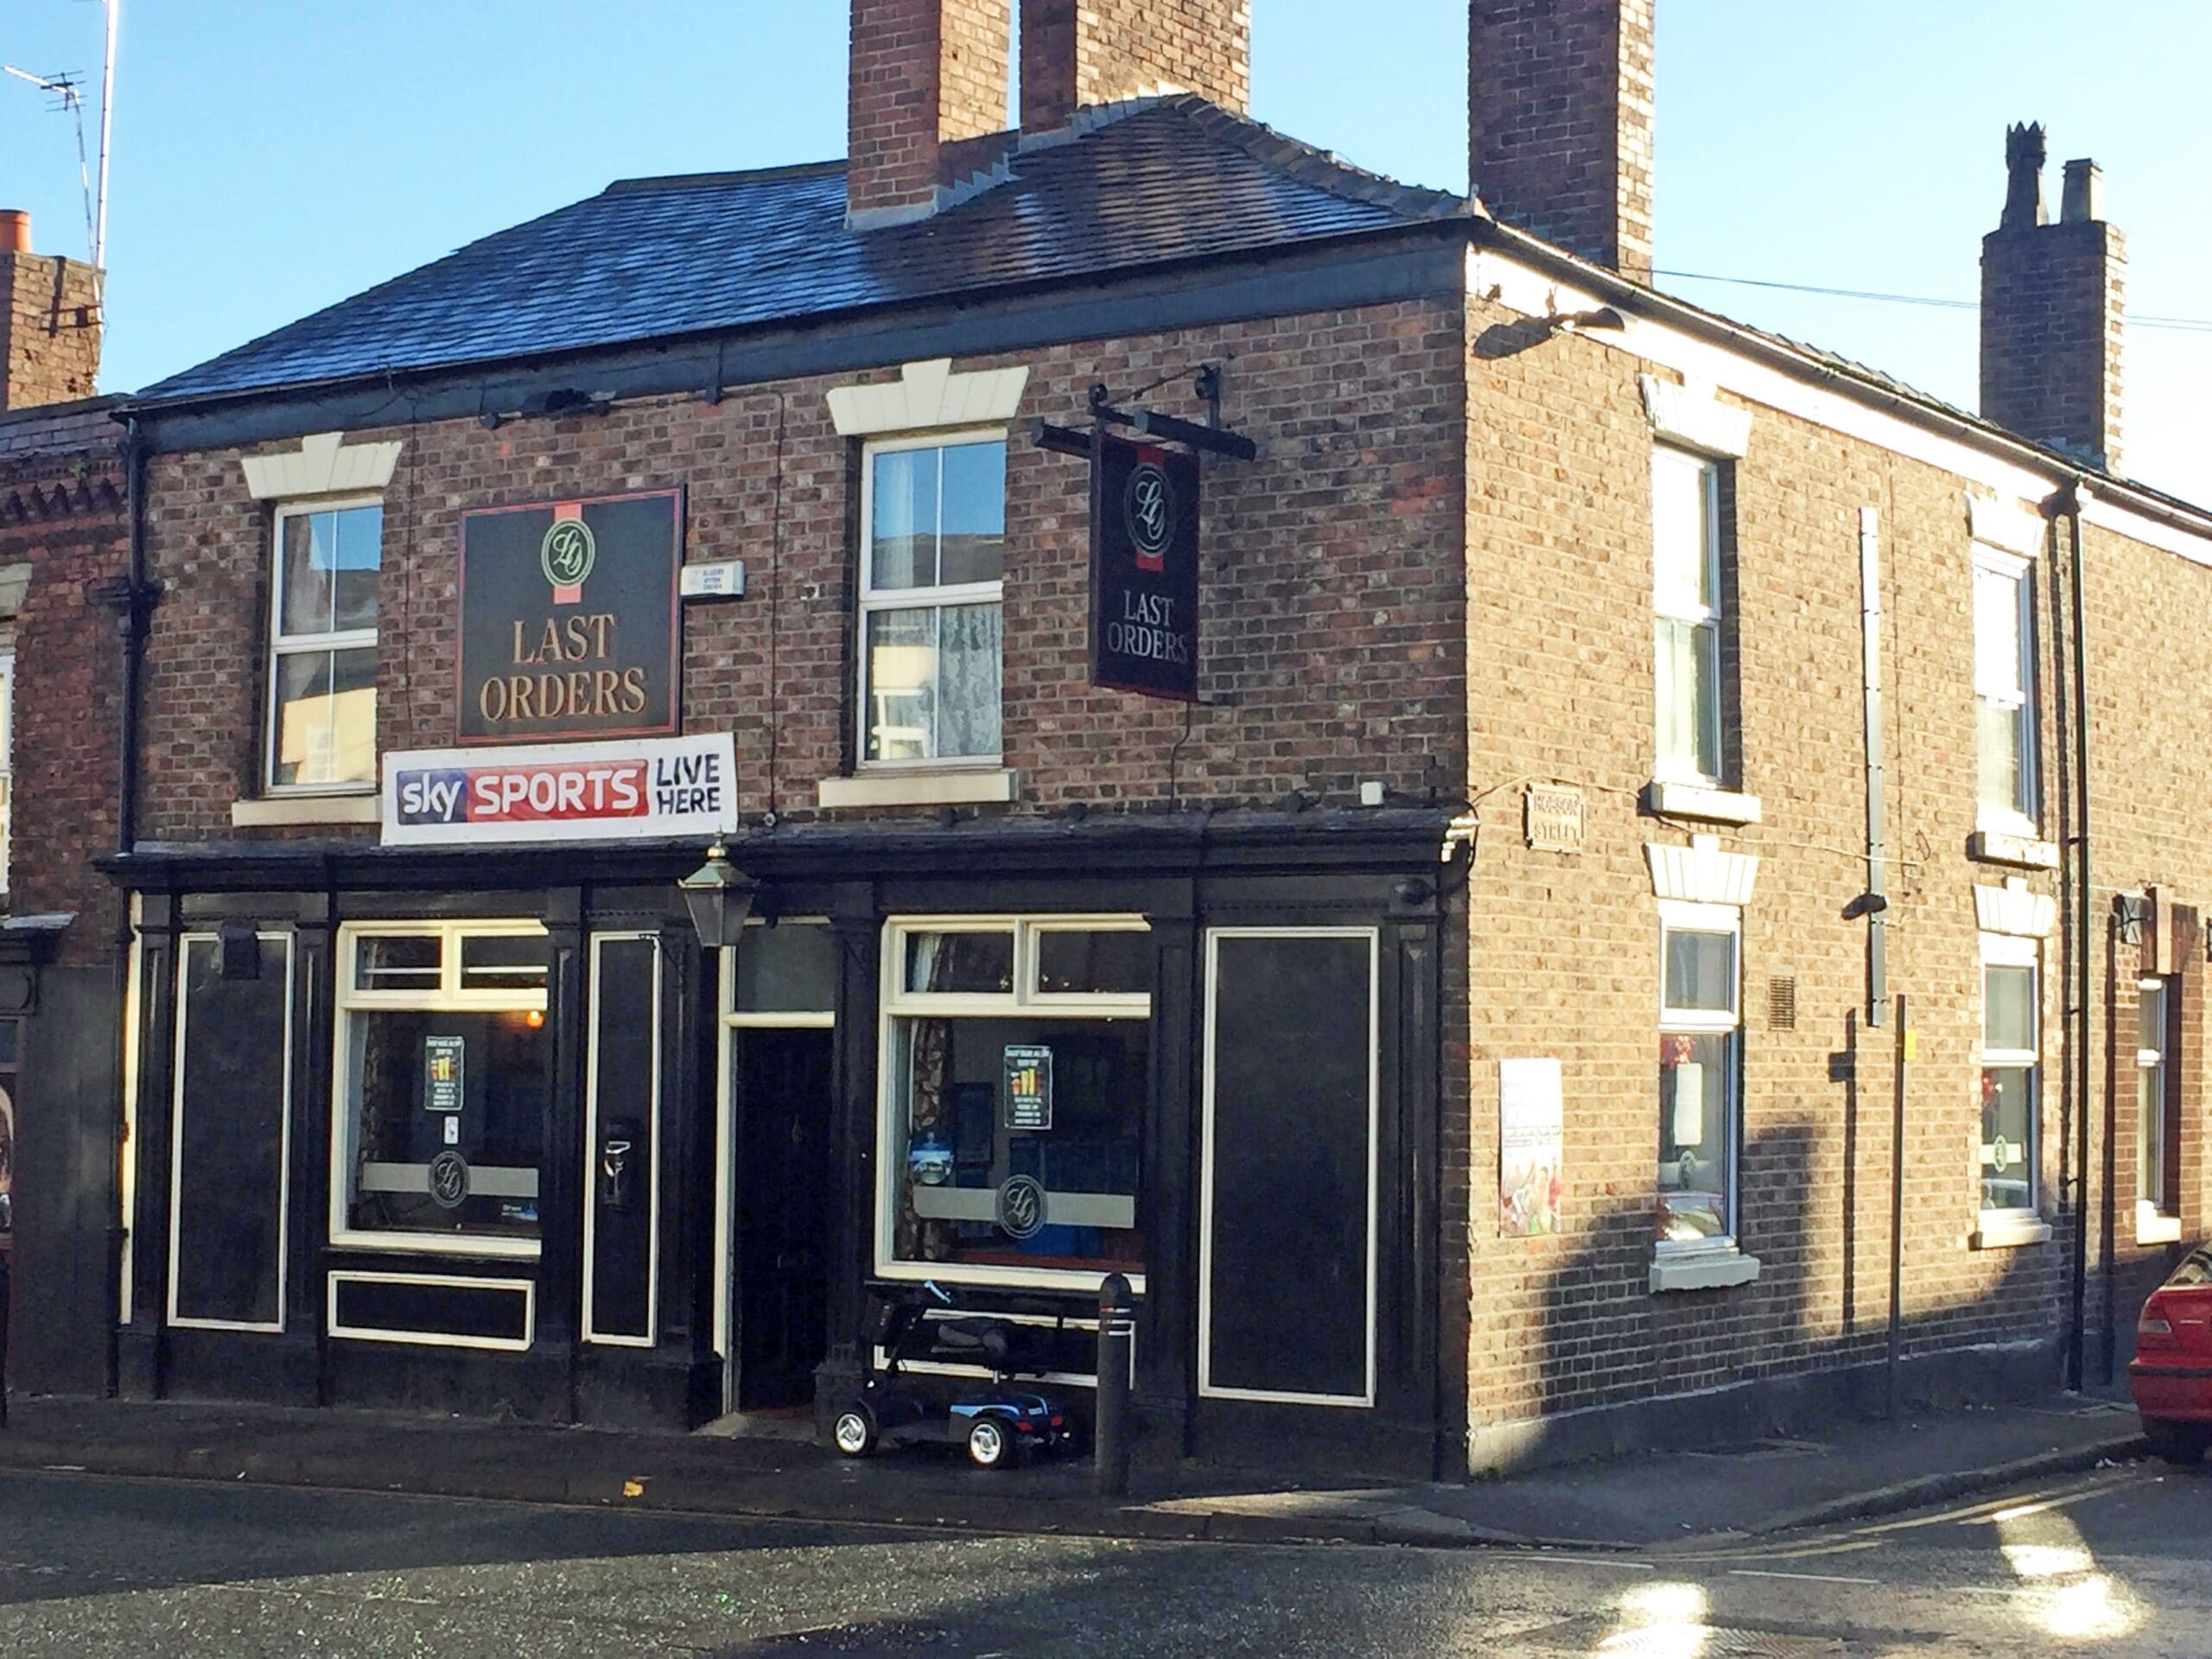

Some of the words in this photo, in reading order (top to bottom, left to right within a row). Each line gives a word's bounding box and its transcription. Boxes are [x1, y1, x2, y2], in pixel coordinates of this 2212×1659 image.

[1123, 589, 1174, 627] LAST
[512, 614, 617, 665] LAST
[1107, 622, 1189, 664] ORDERS
[480, 667, 646, 722] ORDERS
[656, 753, 721, 787] LIVE
[402, 772, 463, 822] sky
[474, 768, 639, 816] SPORTS
[656, 787, 721, 815] HERE
